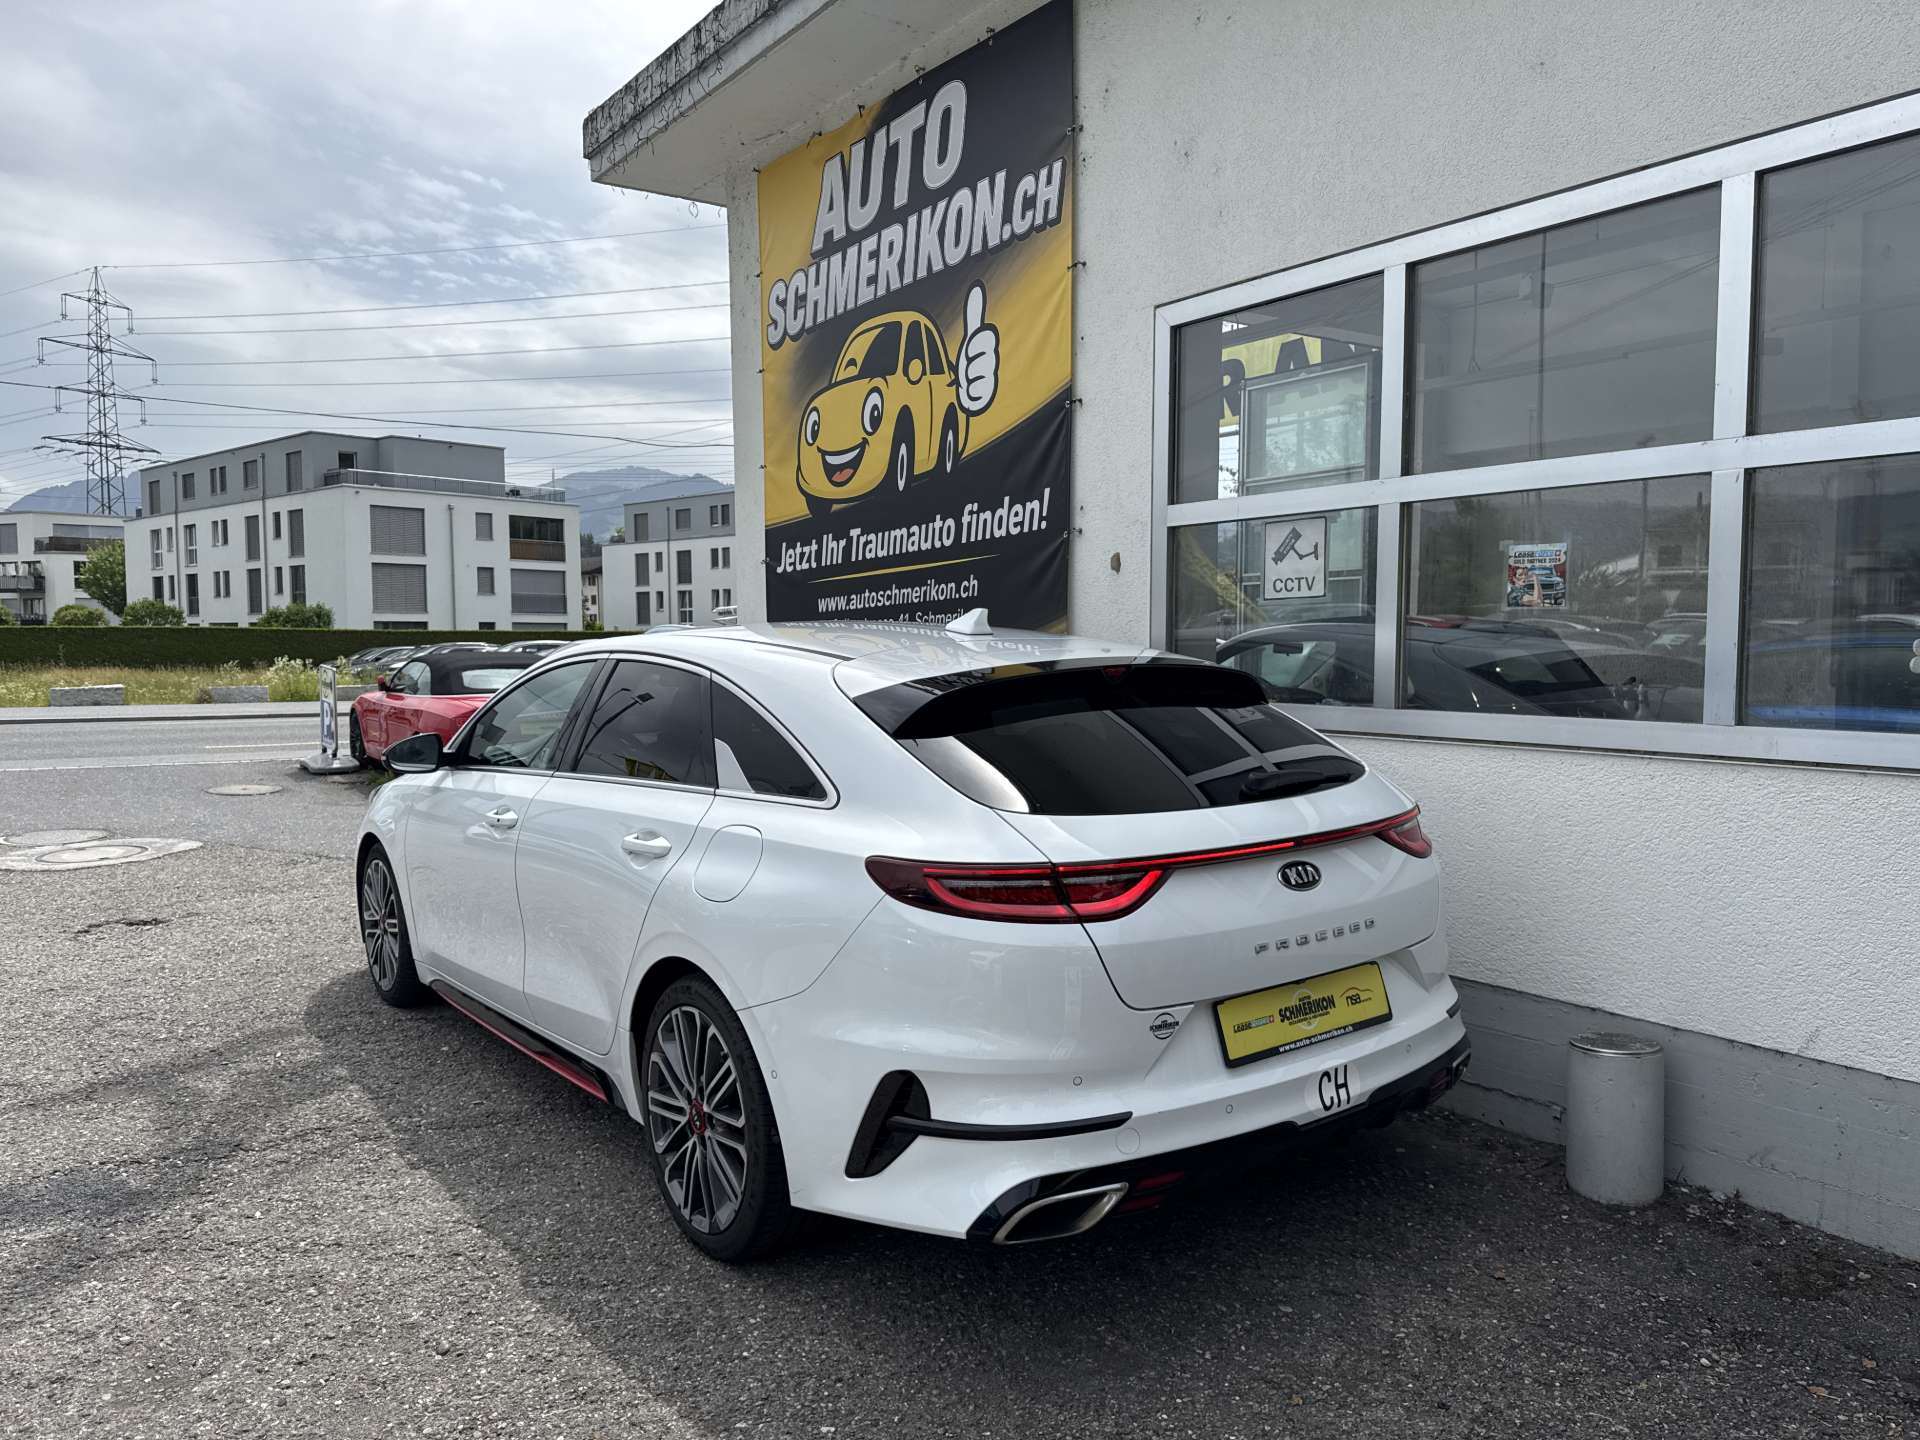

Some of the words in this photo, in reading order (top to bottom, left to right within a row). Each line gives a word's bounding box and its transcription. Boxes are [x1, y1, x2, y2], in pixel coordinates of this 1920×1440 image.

[811, 79, 967, 252] AUTO
[766, 157, 1065, 345] SCHMERIKON.CH
[776, 537, 818, 574] Jetzt
[821, 533, 847, 566] Ihr
[849, 516, 956, 562] Traumauto
[961, 487, 1051, 544] finden!
[817, 574, 979, 613] www.autoschmerikon.ch
[1272, 576, 1316, 593] CCTV
[323, 702, 331, 736] P
[1284, 864, 1319, 886] KIA
[1254, 917, 1376, 955] PROCEED
[1279, 995, 1336, 1023] SCHMERIKON
[1318, 1064, 1351, 1112] CH
